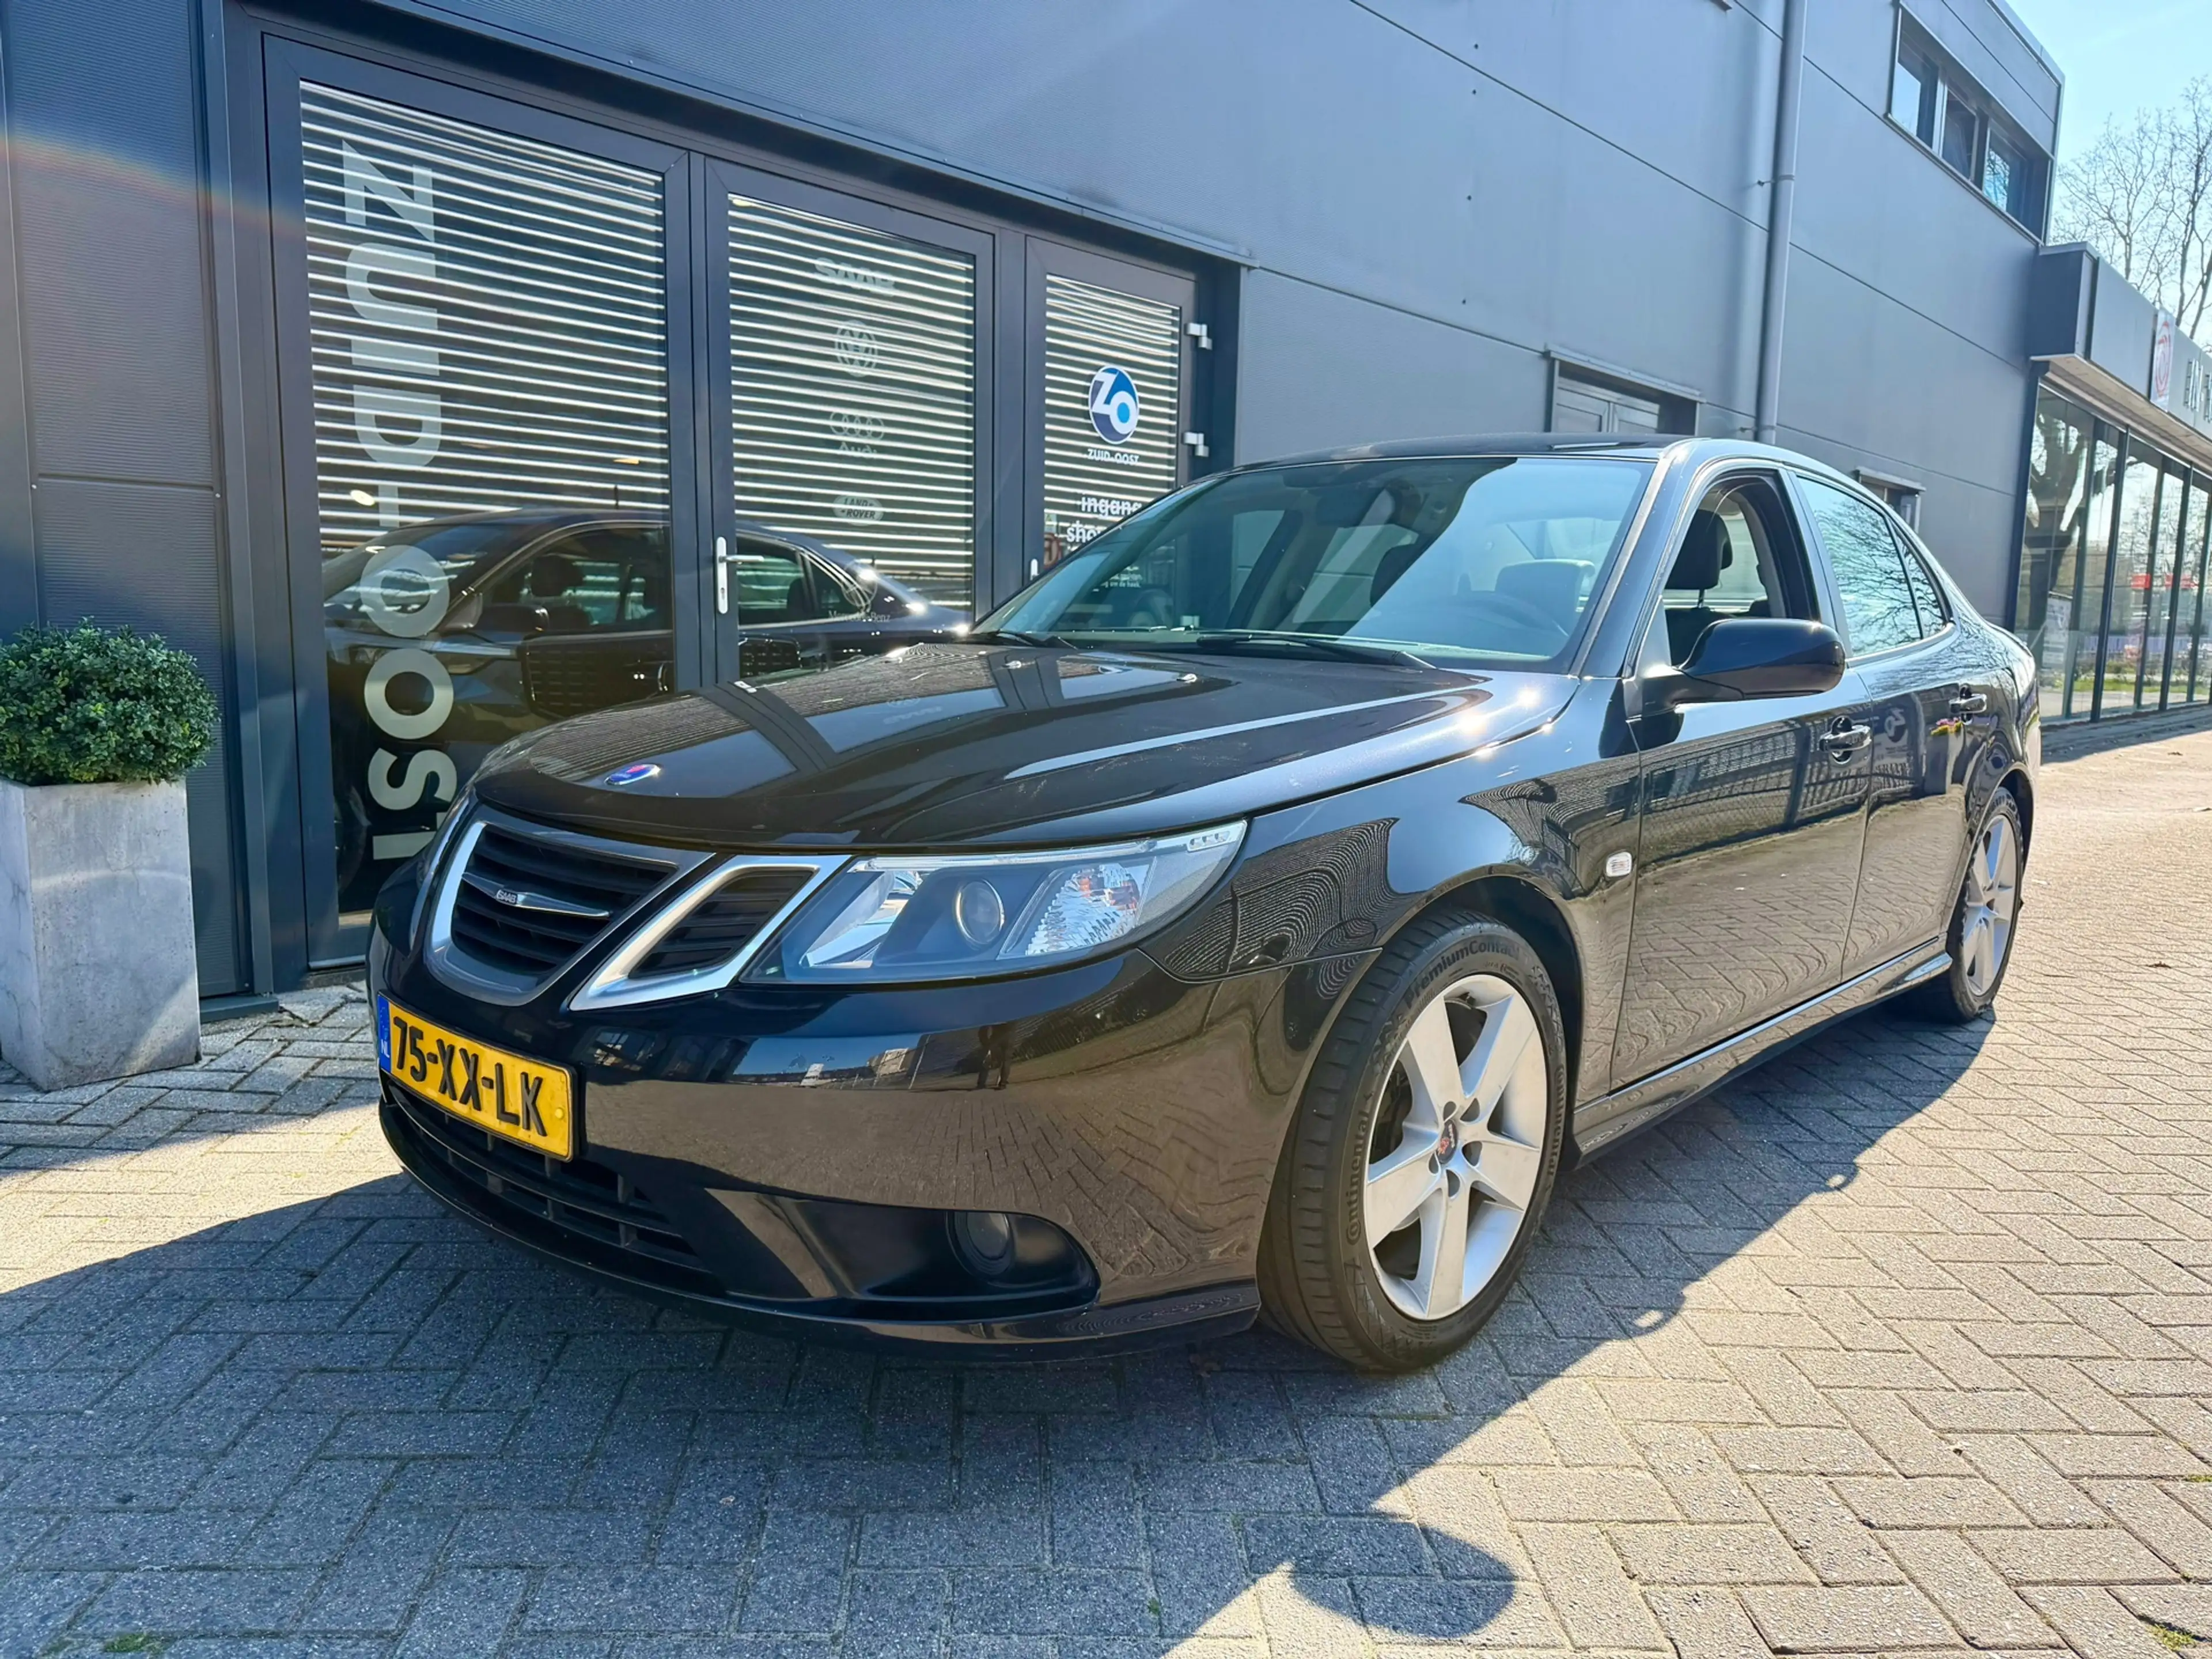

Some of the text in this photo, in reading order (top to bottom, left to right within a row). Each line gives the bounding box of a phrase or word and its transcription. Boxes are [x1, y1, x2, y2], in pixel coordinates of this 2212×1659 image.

[813, 257, 896, 297] SAAB
[839, 441, 878, 459] Audi
[1087, 448, 1140, 465] ZUID-OOST
[844, 498, 868, 508] LAND
[847, 509, 876, 519] ROVER
[1066, 521, 1101, 543] sho
[496, 889, 517, 904] SAAB
[380, 1039, 391, 1059] NL
[393, 1016, 548, 1137] 75-XX-LK
[1346, 1109, 1369, 1245] Continental
